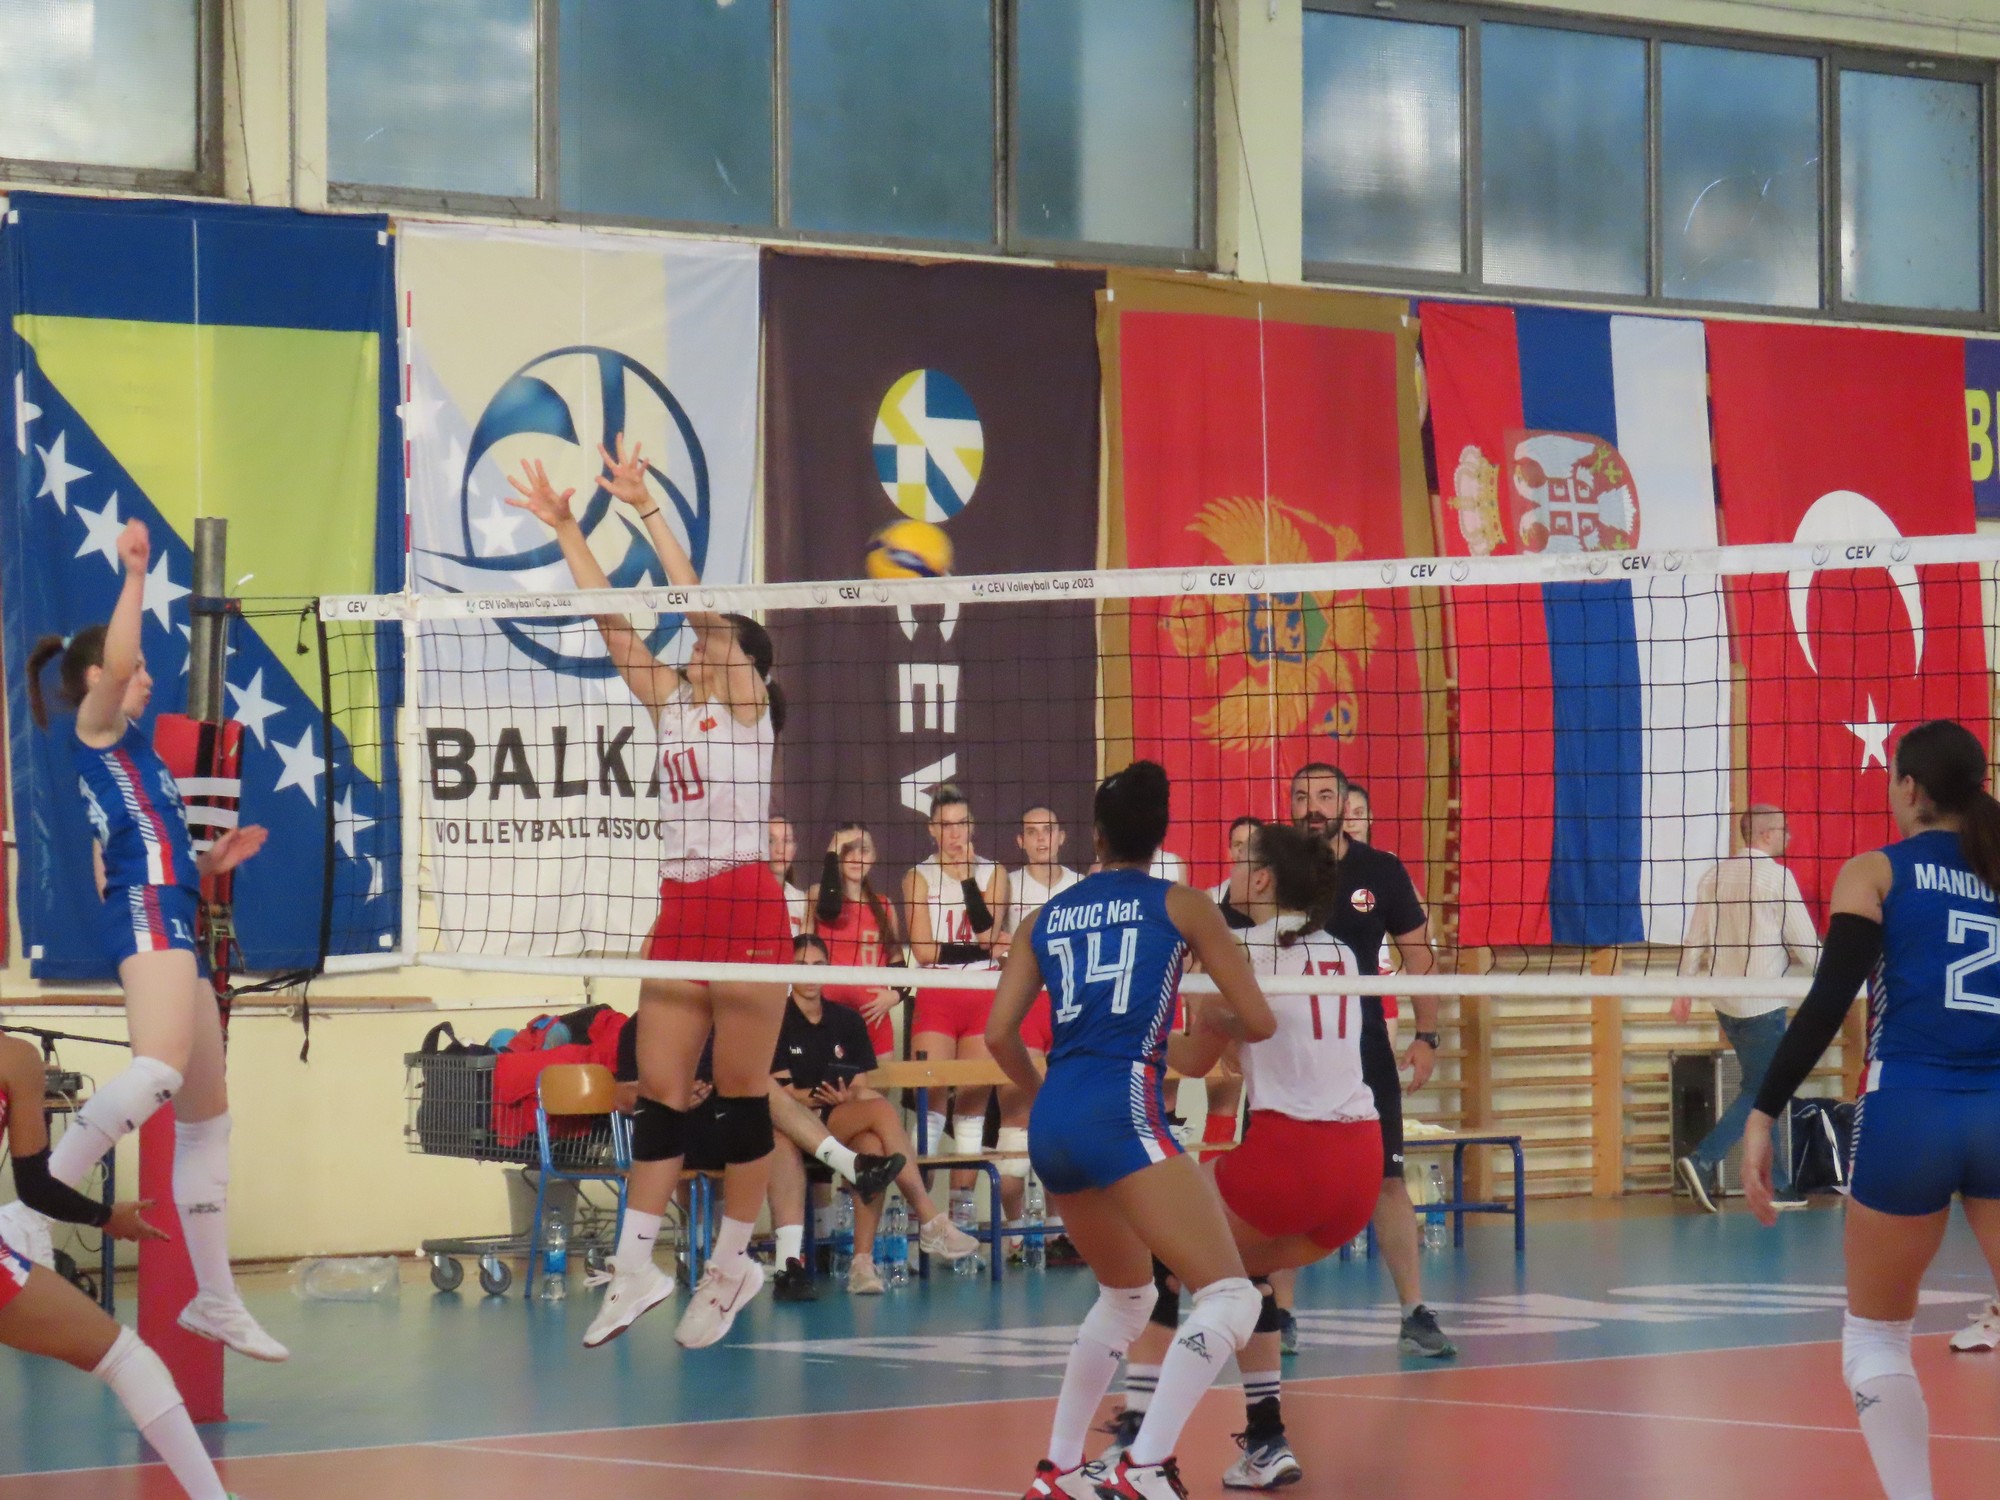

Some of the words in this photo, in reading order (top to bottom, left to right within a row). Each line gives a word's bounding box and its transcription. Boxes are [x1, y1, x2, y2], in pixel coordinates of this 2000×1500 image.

[1965, 389, 2000, 482] B
[1621, 556, 1651, 570] CEV
[1845, 545, 1876, 560] CEV
[1210, 572, 1236, 586] CEV
[1410, 564, 1437, 578] CEV
[839, 587, 861, 599] CEV
[987, 582, 1005, 593] CEV
[1007, 580, 1050, 593] Volleyball
[1052, 579, 1069, 591] Cup
[1072, 577, 1094, 589] 2023
[347, 601, 367, 613] CEV
[478, 599, 494, 610] CEV
[535, 598, 551, 608] Cup
[667, 592, 689, 605] CEV
[426, 725, 660, 801] BALK
[663, 747, 705, 804] 10
[435, 817, 591, 844] VOLLEYBALL
[1914, 864, 2000, 903] MANDO
[1047, 903, 1103, 934] ČIKUC
[1106, 899, 1143, 925] Nat.
[1047, 928, 1138, 1025] 14
[1305, 961, 1347, 1041] 17
[1178, 1337, 1213, 1364] PEAK
